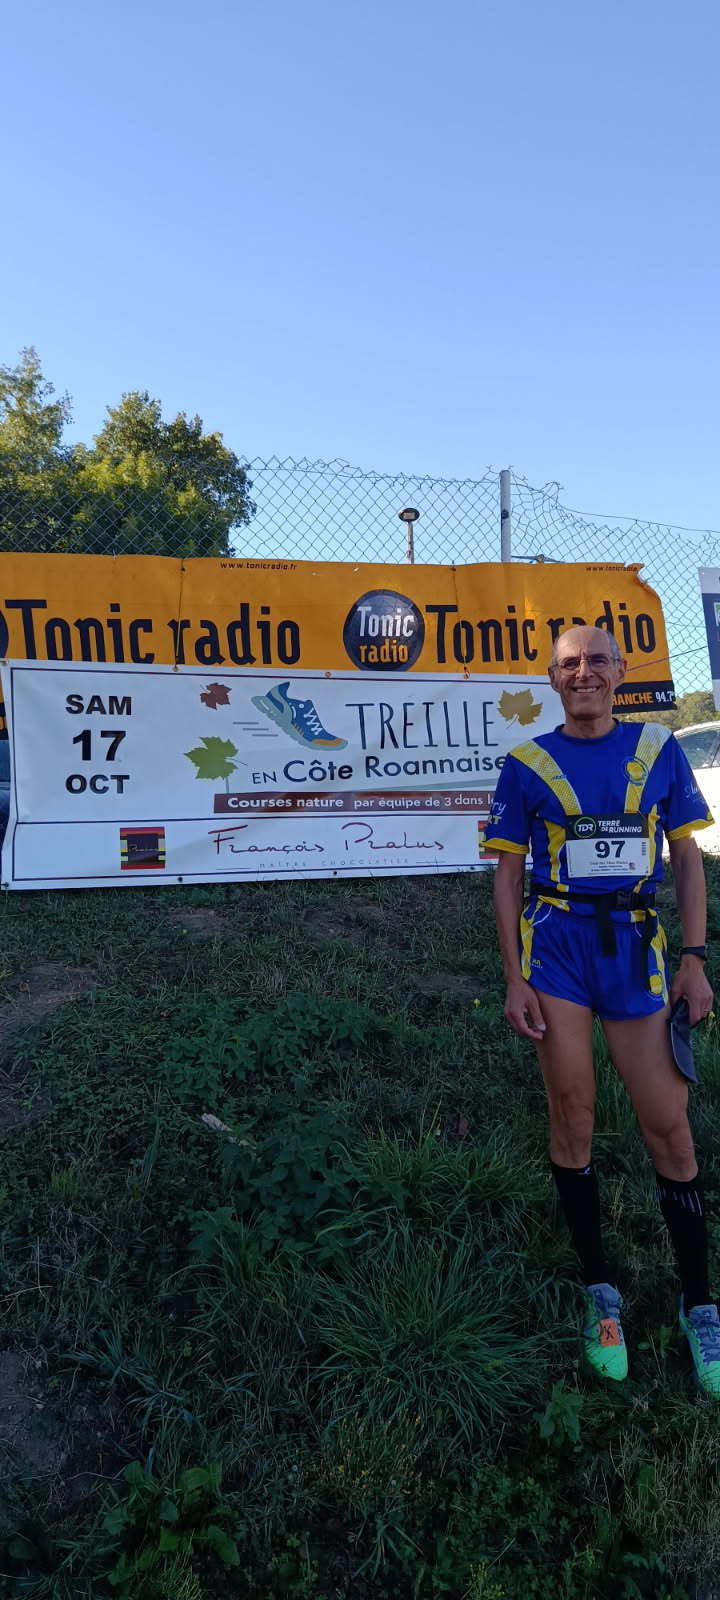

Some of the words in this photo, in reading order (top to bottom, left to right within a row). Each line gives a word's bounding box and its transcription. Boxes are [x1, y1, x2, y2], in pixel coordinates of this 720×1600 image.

[220, 561, 297, 571] www.tonicradio.fr
[5, 599, 155, 664] Tonic
[167, 603, 301, 665] radio
[356, 605, 415, 638] Tonic
[426, 604, 538, 664] Tonic
[359, 639, 409, 664] radio
[65, 694, 132, 715] SAM
[345, 701, 498, 750] TREILLE
[72, 729, 126, 762] 17
[252, 771, 277, 784] EN
[283, 759, 354, 783] Côte
[365, 751, 506, 779] Roannaise
[65, 774, 130, 794] OCT
[227, 796, 292, 809] Courses
[297, 796, 344, 808] nature
[354, 799, 374, 809] par
[378, 797, 421, 808] équipe
[424, 797, 440, 807] de
[444, 797, 452, 806] 3
[454, 793, 484, 805] dans
[577, 823, 594, 832] TDR
[597, 819, 621, 827] TERRE
[208, 824, 324, 855] François
[341, 822, 445, 851] Pralus
[594, 840, 626, 859] 97
